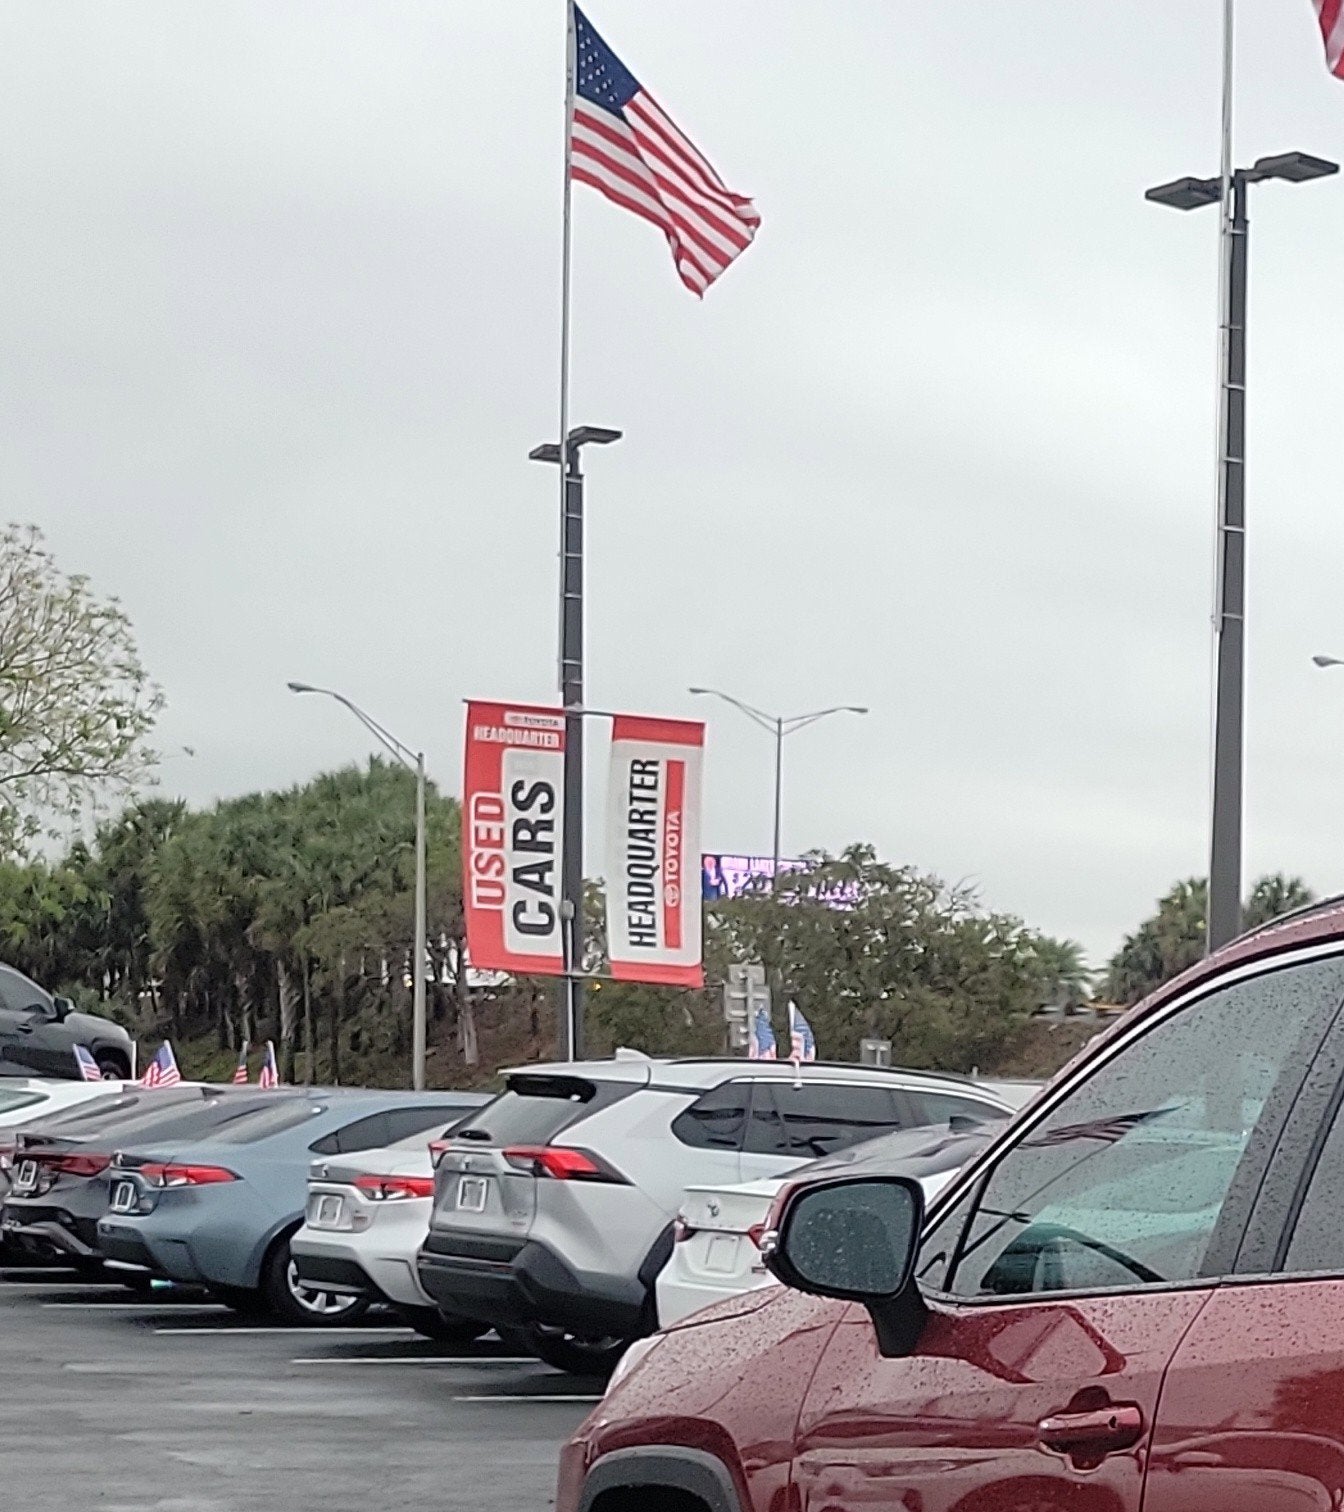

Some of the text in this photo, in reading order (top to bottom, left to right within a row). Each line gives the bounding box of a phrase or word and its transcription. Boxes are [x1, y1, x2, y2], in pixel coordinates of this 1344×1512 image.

[473, 794, 505, 908] USED
[511, 779, 555, 936] CARS
[627, 758, 660, 948] HEADQUARTER
[665, 810, 682, 883] TOYOTA
